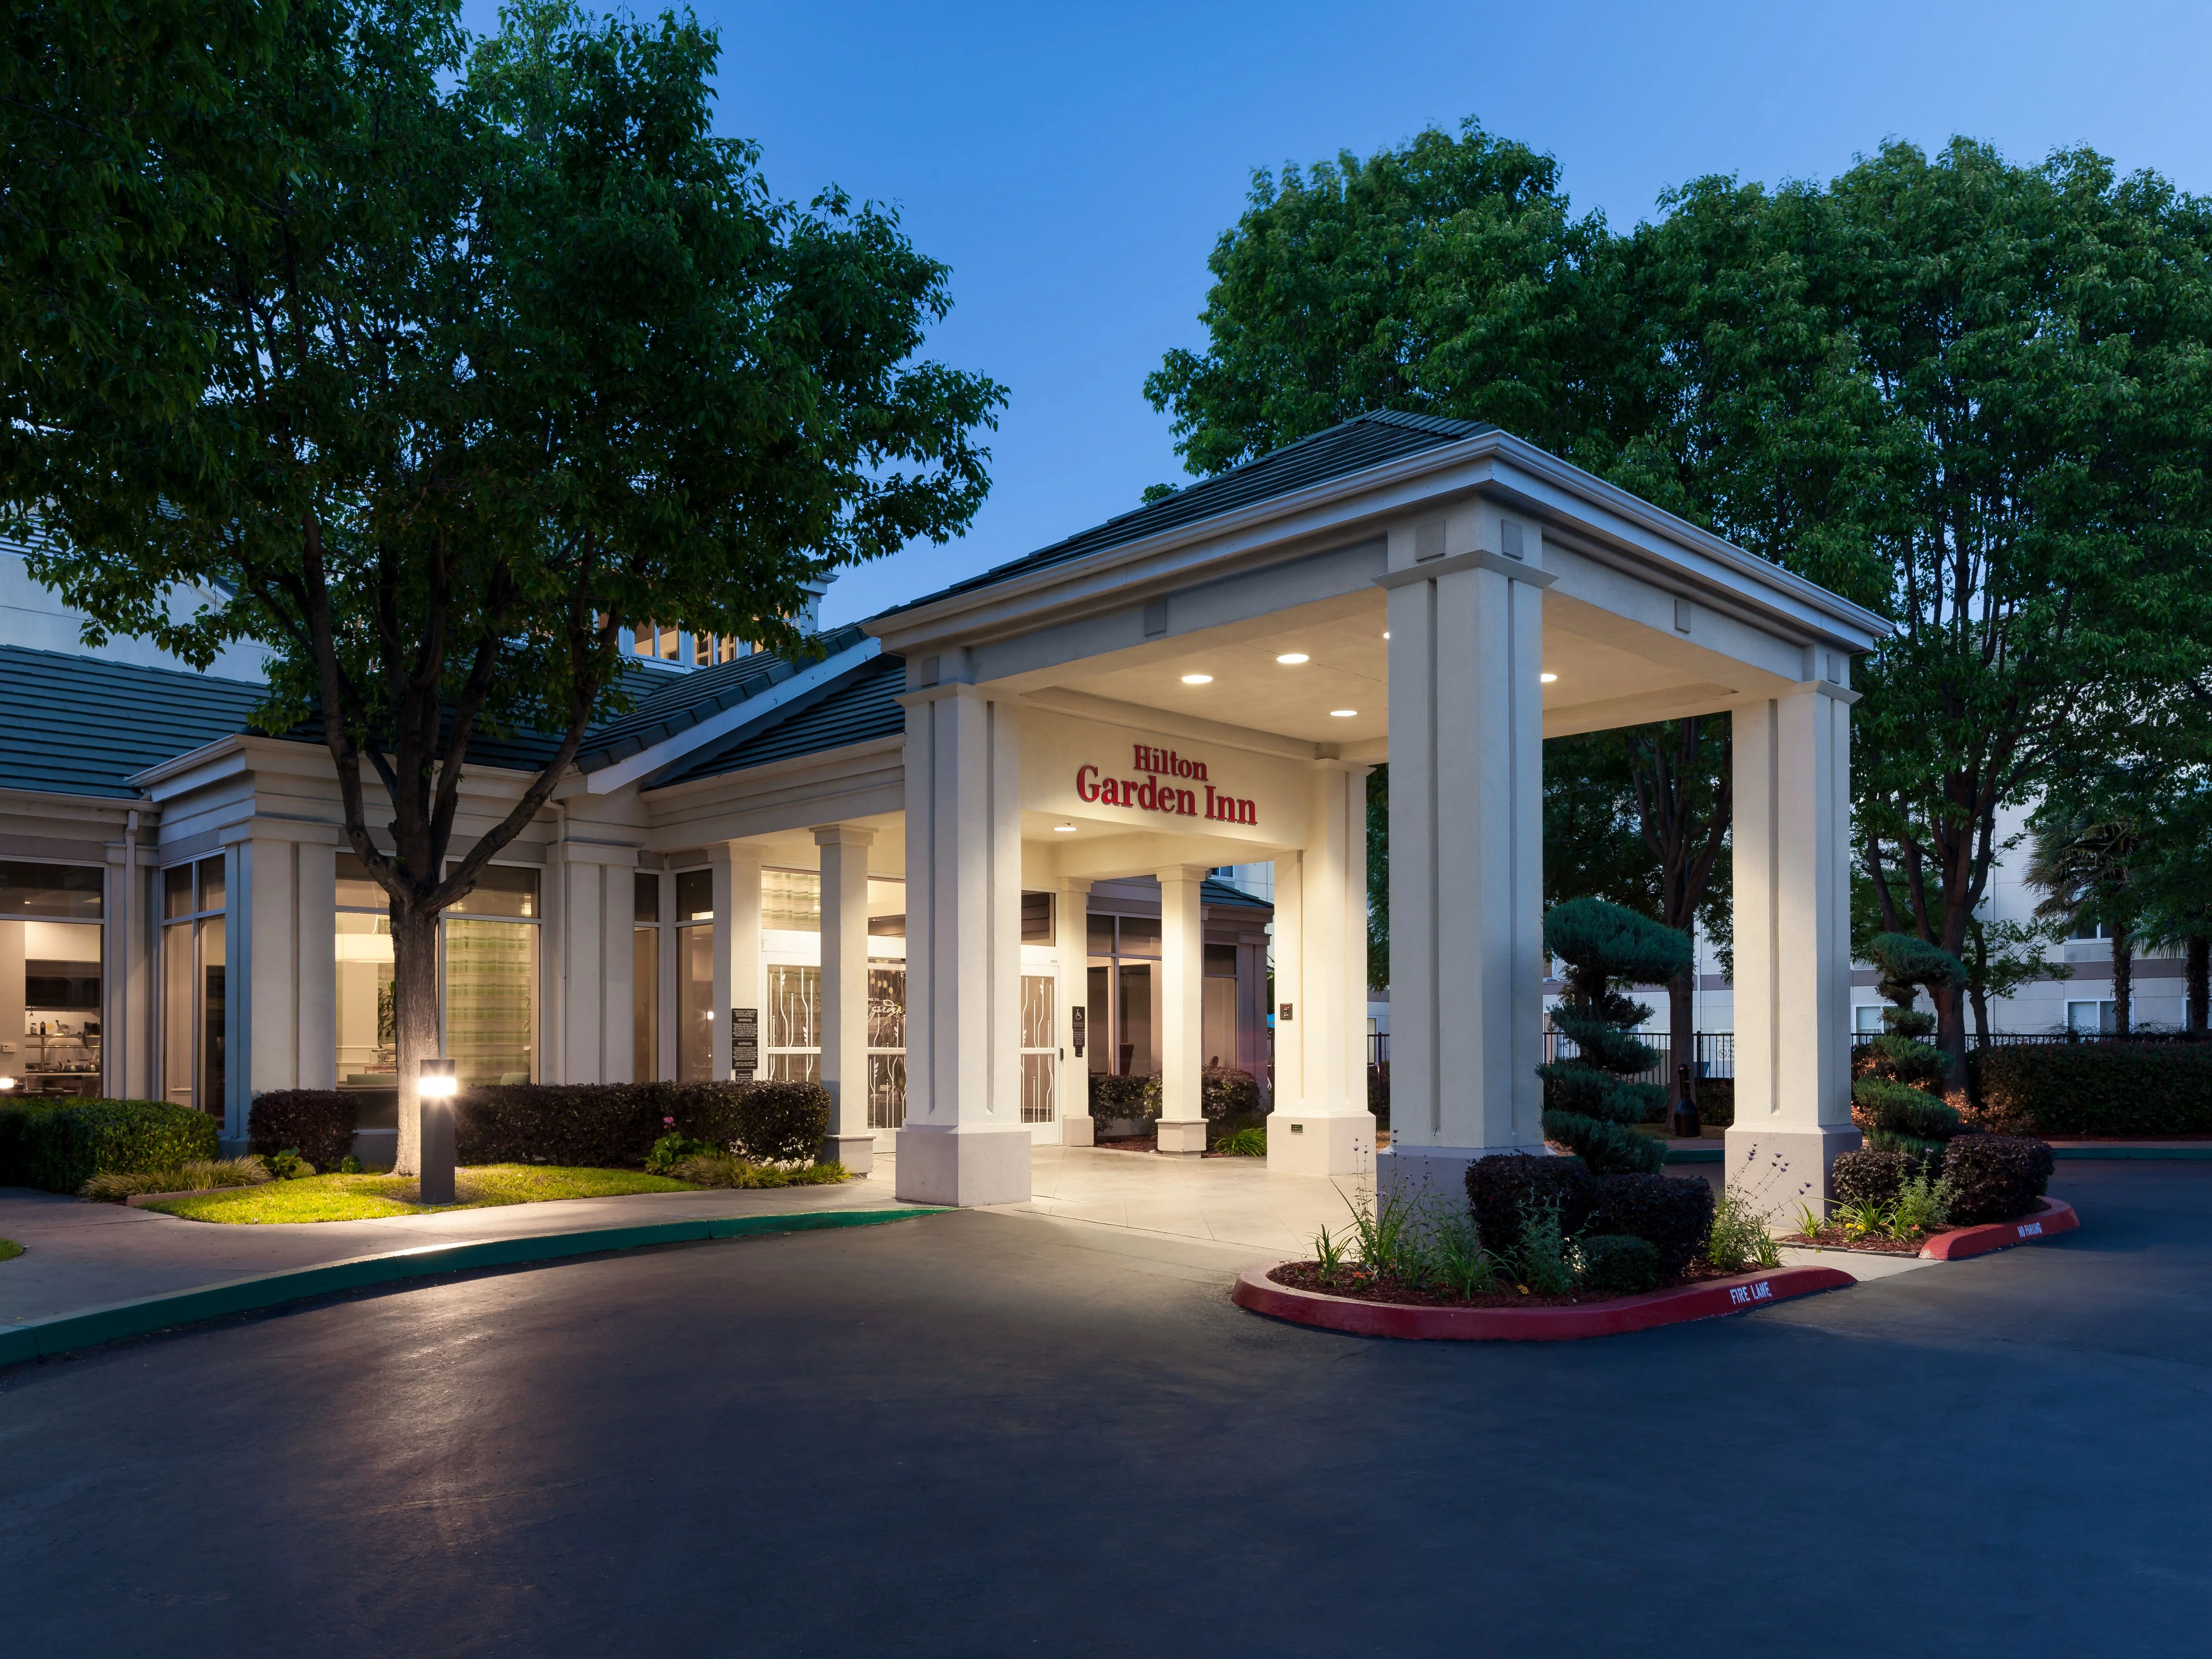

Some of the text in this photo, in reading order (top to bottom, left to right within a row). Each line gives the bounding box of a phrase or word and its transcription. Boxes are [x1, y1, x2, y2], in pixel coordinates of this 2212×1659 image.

[1133, 744, 1209, 781] Hilton
[1077, 765, 1258, 824] Garden Inn
[868, 999, 906, 1023] garden
[2017, 1222, 2042, 1238] NO PARKING
[1730, 1281, 1772, 1305] FIRE LANE
